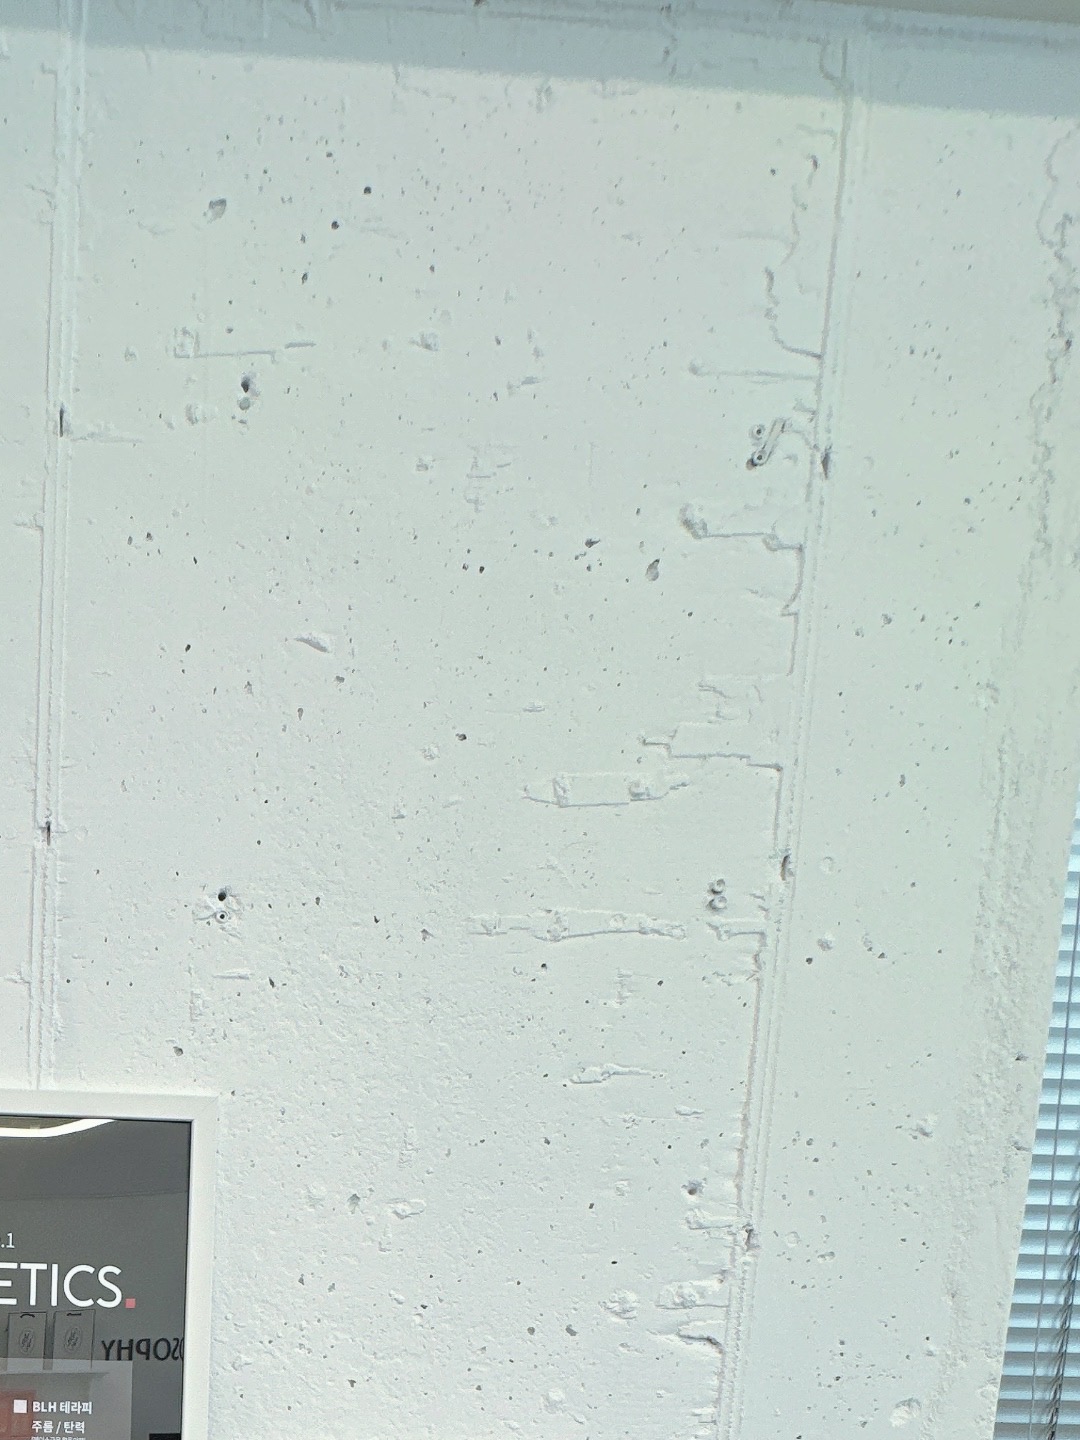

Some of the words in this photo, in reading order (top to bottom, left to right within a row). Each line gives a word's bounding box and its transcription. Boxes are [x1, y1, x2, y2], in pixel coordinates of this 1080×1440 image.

[32, 1401, 57, 1413] BLH
[60, 1401, 93, 1414] 테라피
[32, 1421, 53, 1433] 주름
[64, 1421, 85, 1434] 탄력
